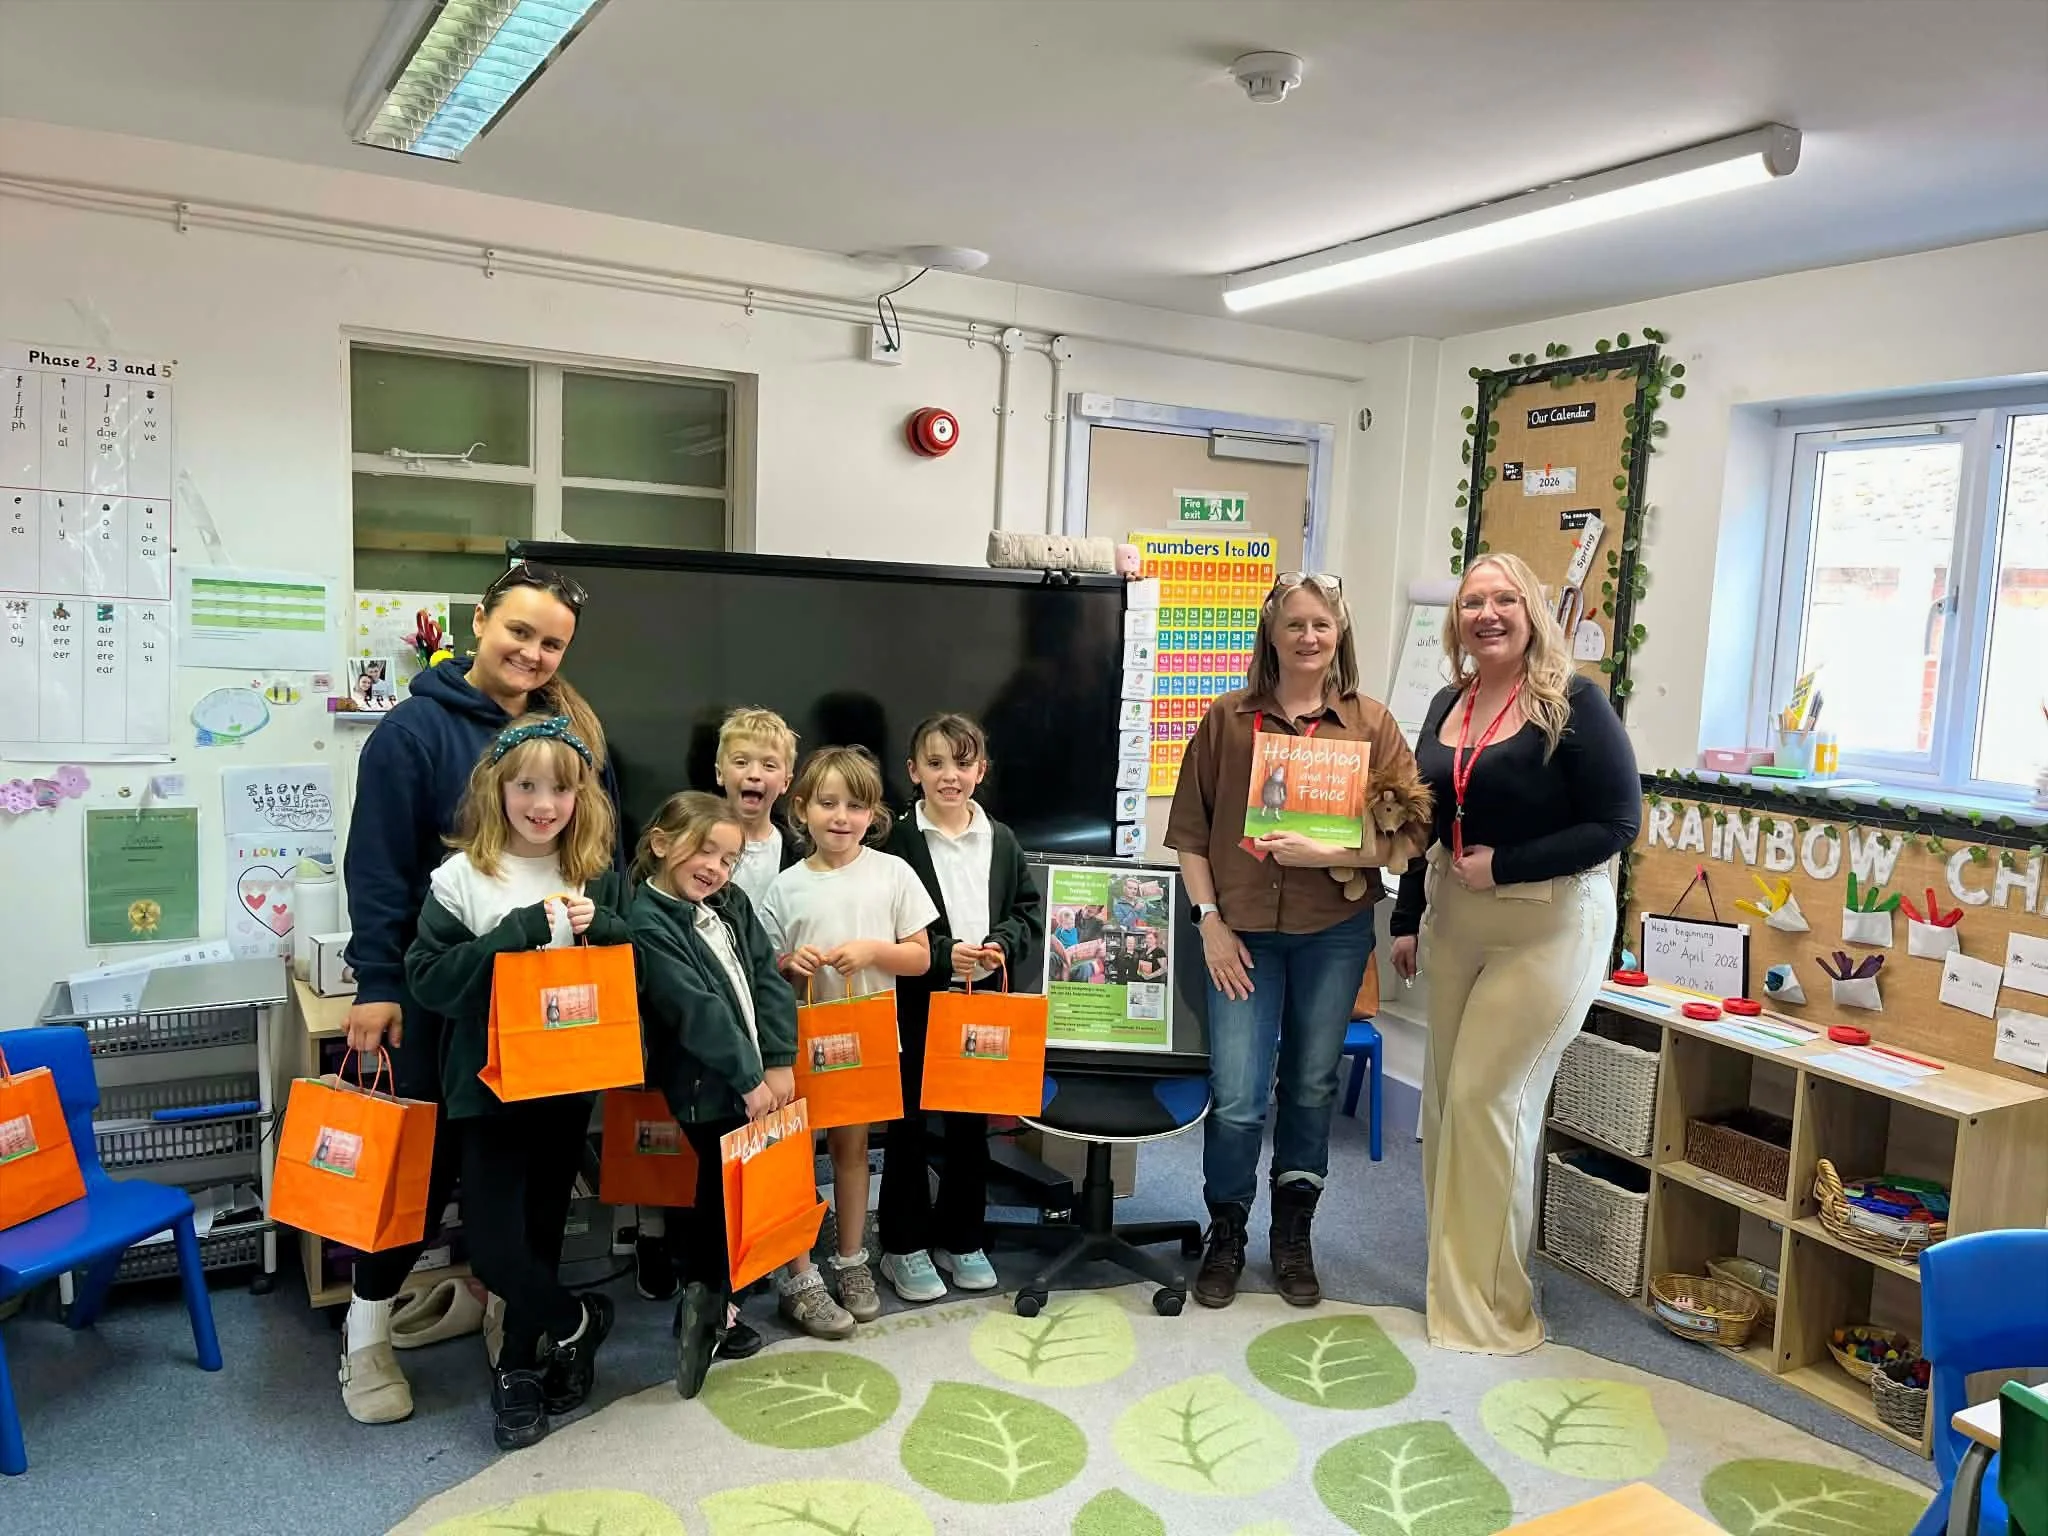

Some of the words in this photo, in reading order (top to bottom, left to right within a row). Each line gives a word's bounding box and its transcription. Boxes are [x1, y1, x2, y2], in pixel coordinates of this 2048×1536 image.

[29, 350, 79, 367] Phase
[86, 357, 101, 371] 2,
[108, 359, 117, 372] 3
[125, 364, 156, 377] and
[162, 366, 171, 377] 5
[14, 405, 24, 419] ff
[1531, 411, 1548, 425] Our
[1550, 406, 1590, 422] Calendar
[11, 420, 26, 432] ph
[58, 423, 68, 434] le
[96, 427, 117, 440] dge
[144, 434, 157, 442] ve
[58, 437, 68, 448] al
[100, 442, 113, 454] ge
[1540, 478, 1560, 487] 2026
[1185, 499, 1201, 508] Fire
[1185, 510, 1201, 519] exit
[11, 526, 25, 534] ea
[142, 548, 156, 556] ou
[1146, 538, 1219, 556] numbers
[1225, 540, 1230, 556] 1
[1232, 547, 1244, 557] to
[1247, 541, 1270, 557] 100
[1576, 533, 1595, 569] Spring
[142, 611, 155, 621] zh
[52, 624, 71, 632] ear
[98, 626, 112, 634] air
[10, 636, 24, 647] oy
[53, 638, 71, 646] ere
[97, 639, 114, 648] are
[142, 641, 155, 649] su
[52, 651, 71, 659] eer
[97, 652, 114, 661] ere
[96, 666, 114, 674] ear
[1263, 739, 1361, 773] Hedgehog
[1300, 772, 1321, 782] and
[1326, 772, 1347, 785] the
[1297, 785, 1346, 801] Fence
[253, 848, 287, 858] LOVE
[1648, 801, 1903, 886] RAINBOW
[1945, 846, 2048, 920] CH
[1656, 939, 1677, 954] 20th
[1680, 946, 1704, 968] April
[1713, 953, 1739, 969] 2026
